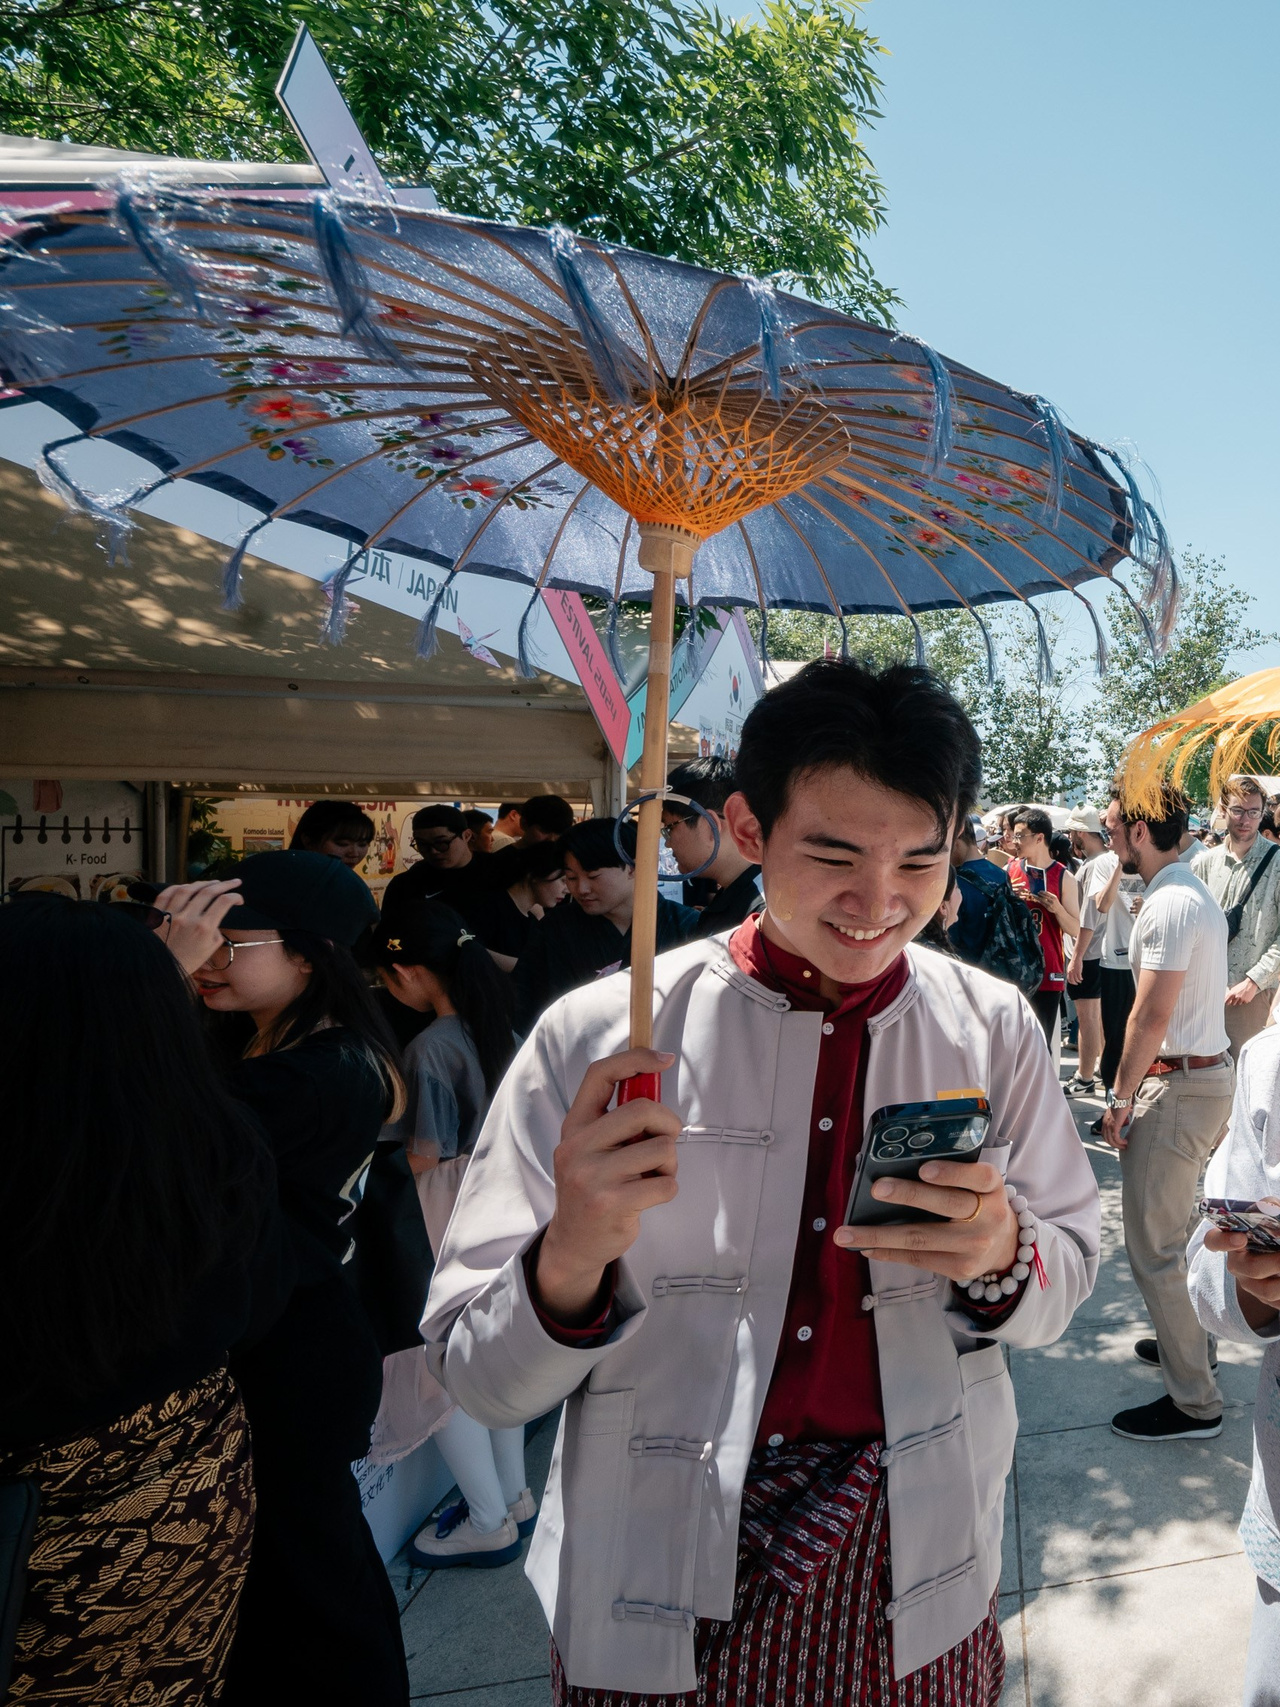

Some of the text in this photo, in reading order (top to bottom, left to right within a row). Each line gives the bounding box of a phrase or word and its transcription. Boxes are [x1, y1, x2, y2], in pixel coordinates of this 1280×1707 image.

[347, 541, 392, 585] 日本
[406, 569, 458, 613] JAPAN
[594, 667, 617, 721] 2024
[266, 828, 284, 836] Island
[81, 853, 107, 865] Food
